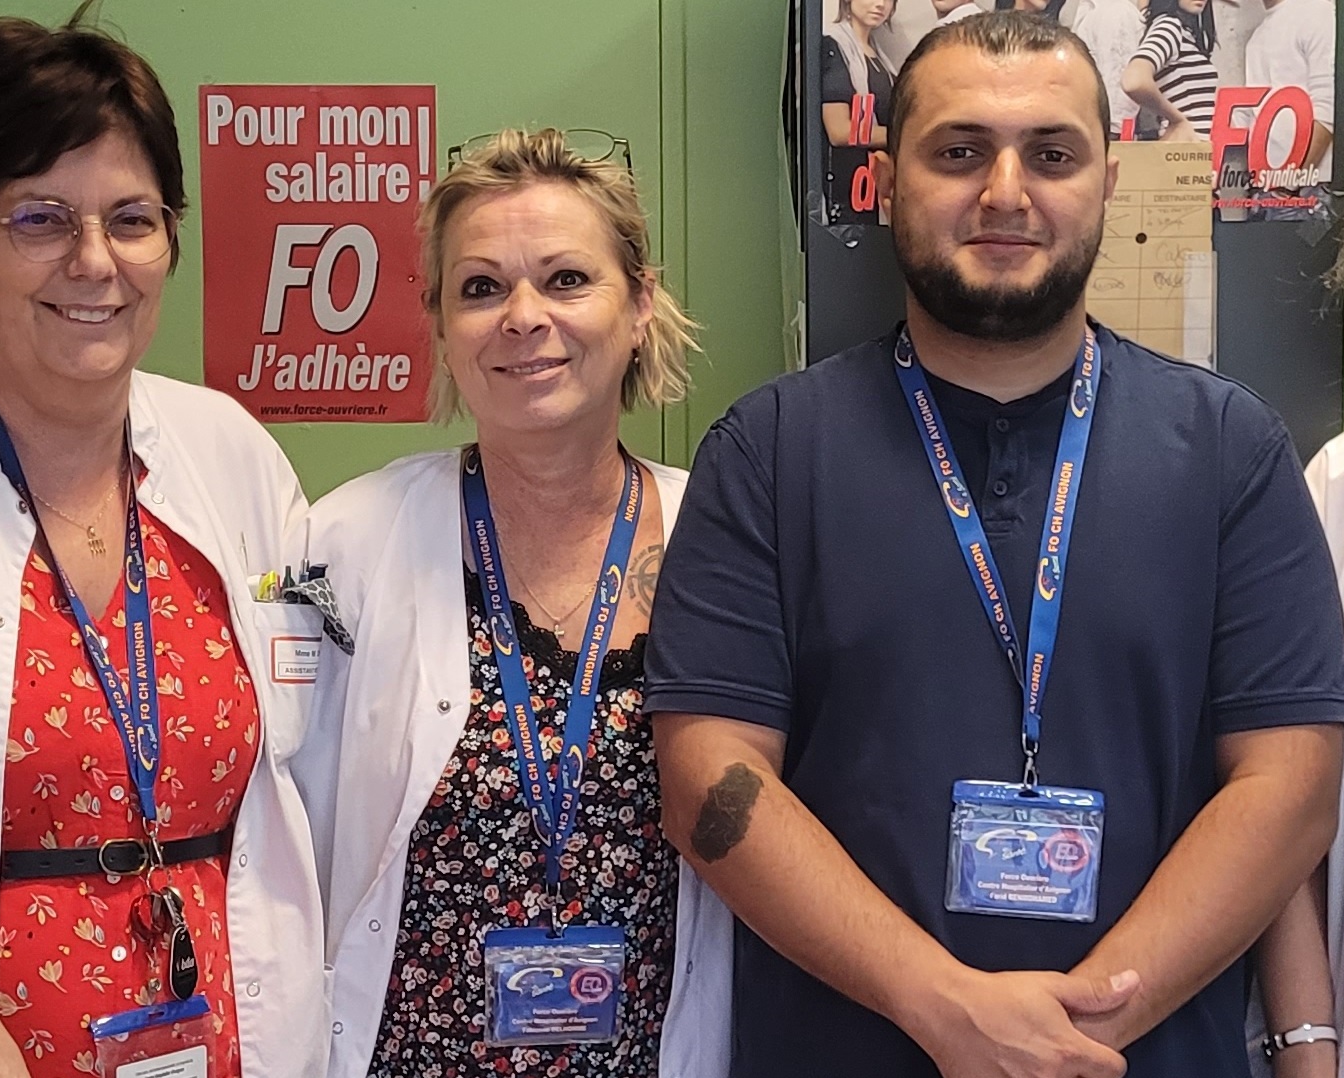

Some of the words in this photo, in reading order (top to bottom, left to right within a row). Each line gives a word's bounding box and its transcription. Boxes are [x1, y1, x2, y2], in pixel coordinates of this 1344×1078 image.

[207, 94, 305, 146] Pour
[319, 105, 411, 146] mon
[1210, 86, 1315, 189] FO
[265, 151, 411, 203] salaire
[1176, 176, 1191, 185] NE
[261, 223, 380, 335] FO
[237, 343, 411, 391] J'adhère
[1081, 362, 1093, 377] FO
[260, 403, 389, 416] www.force-ouvriere.fr
[914, 389, 941, 440] AVIGNON
[933, 440, 947, 462] CH
[939, 460, 954, 477] FO
[1054, 461, 1074, 515] AVIGNON
[1050, 515, 1063, 535] CH
[475, 519, 496, 573] AVIGNON
[1047, 535, 1059, 553] FO
[969, 542, 1000, 600] AVIGNON
[487, 573, 497, 595] CH
[492, 595, 503, 610] FO
[993, 602, 1005, 622] CH
[597, 606, 610, 622] FO
[591, 622, 603, 642] CH
[133, 621, 148, 679] AVIGNON
[580, 641, 602, 696] AVIGNON
[138, 681, 149, 702] CH
[139, 703, 151, 720] FO
[514, 704, 536, 760] AVIGNON
[526, 762, 539, 782] CH
[530, 783, 543, 801] FO
[560, 792, 573, 810] FO
[557, 812, 569, 832] CH
